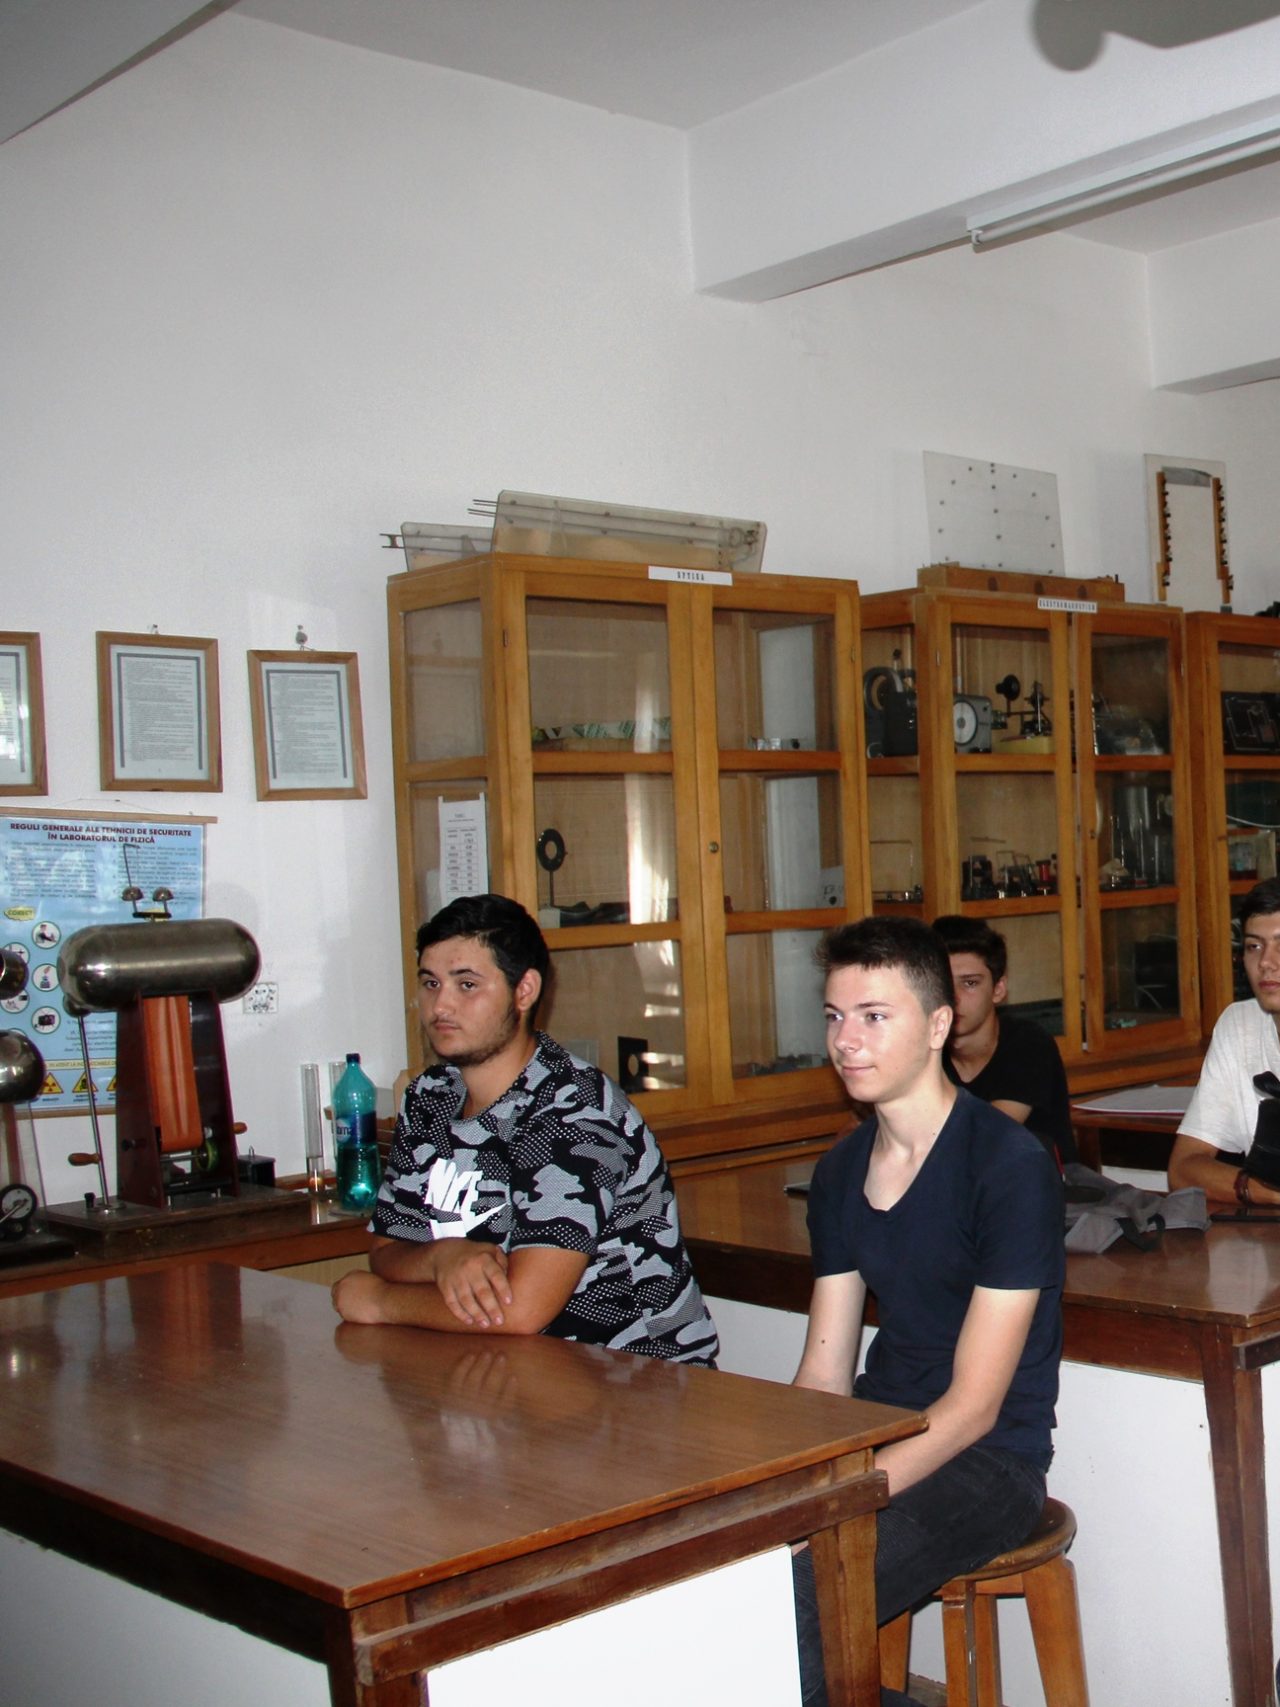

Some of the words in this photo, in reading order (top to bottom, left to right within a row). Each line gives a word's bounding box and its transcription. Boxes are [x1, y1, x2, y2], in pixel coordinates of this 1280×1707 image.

[10, 823, 41, 831] REGULI
[42, 824, 83, 833] GENERALE
[149, 828, 192, 837] SECURITATE
[59, 833, 117, 843] LABORATORUL
[118, 835, 128, 843] DE
[130, 835, 155, 844] FIZICĂ
[424, 1157, 483, 1217] NIKE
